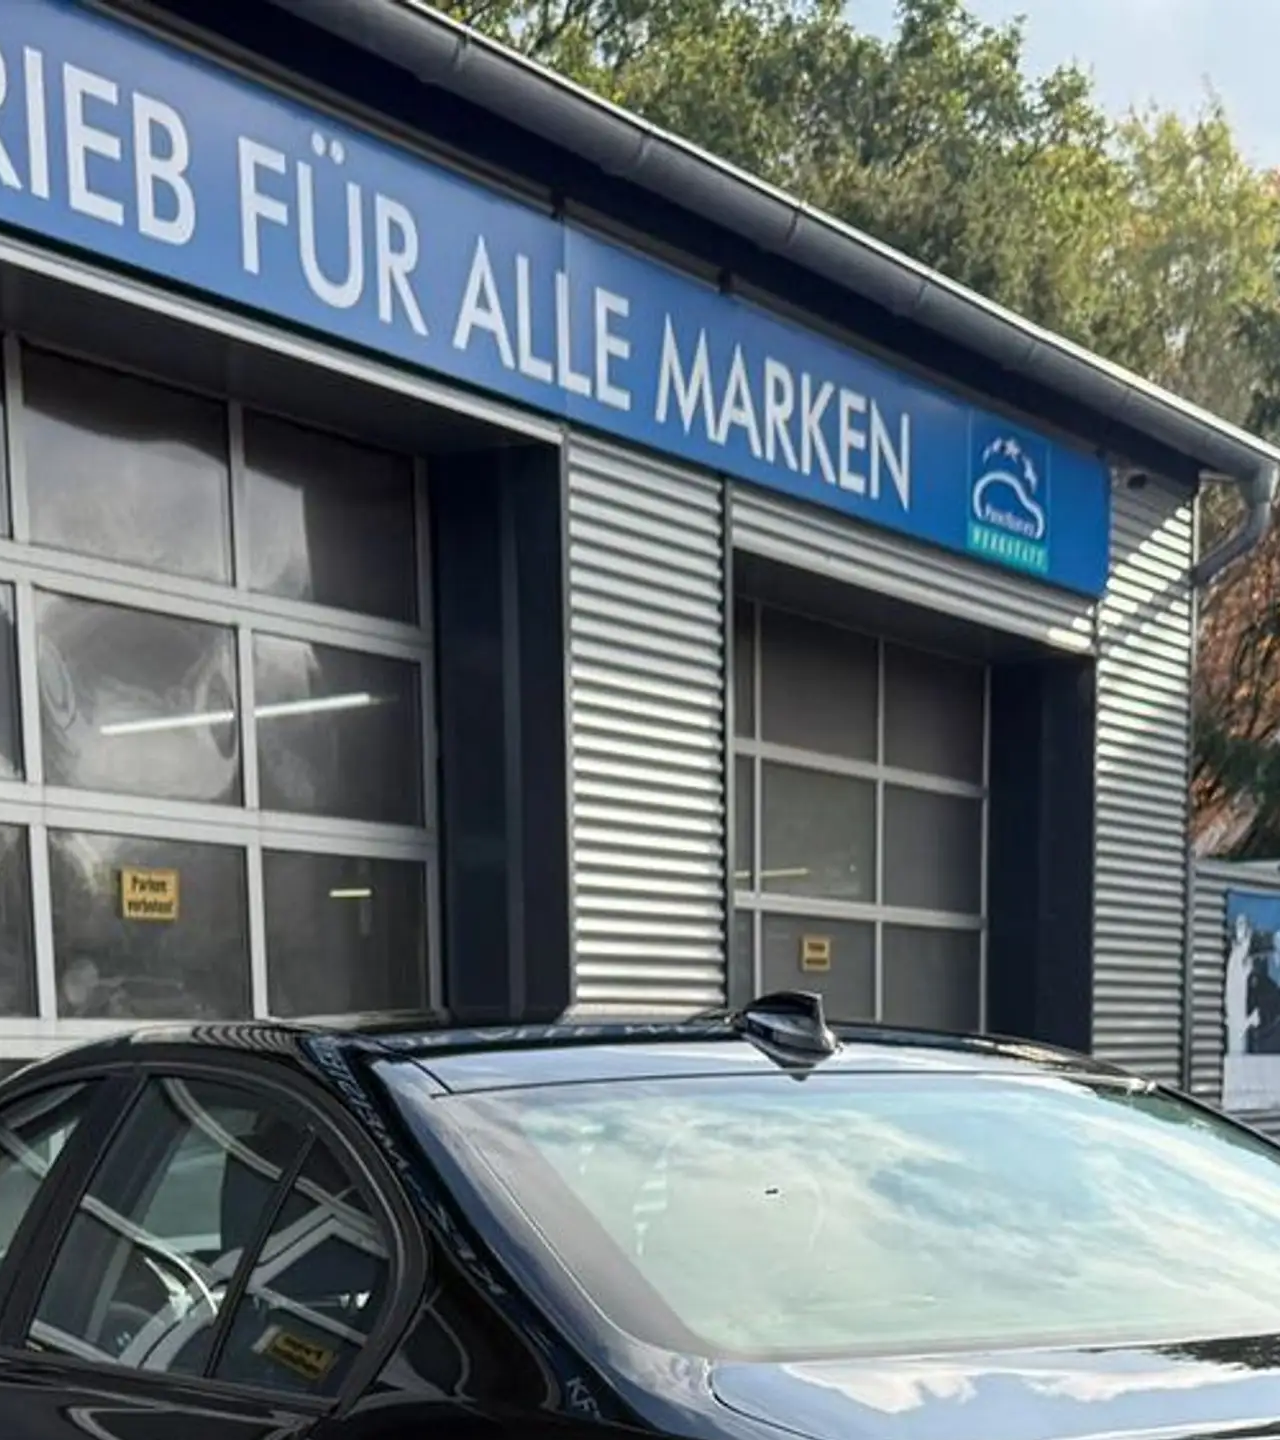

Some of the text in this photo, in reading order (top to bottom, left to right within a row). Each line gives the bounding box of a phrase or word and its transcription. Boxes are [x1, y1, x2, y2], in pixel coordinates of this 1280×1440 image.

[237, 131, 429, 336] FÜR
[453, 235, 632, 412] ALLE
[656, 313, 911, 511] MARKEN
